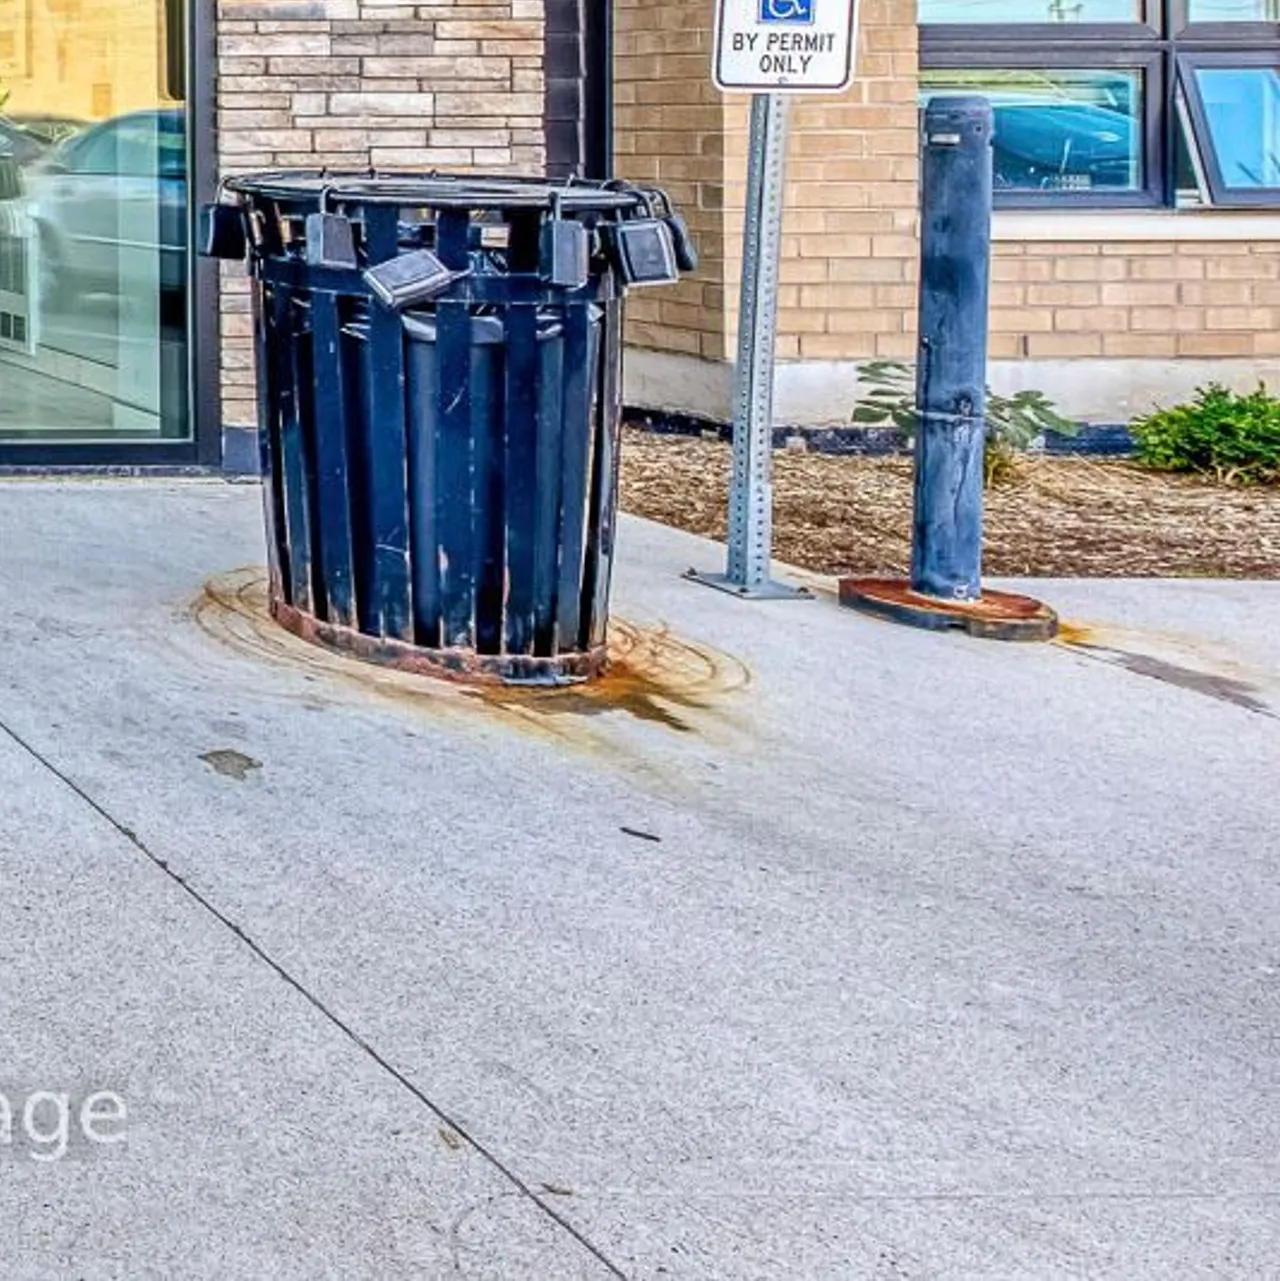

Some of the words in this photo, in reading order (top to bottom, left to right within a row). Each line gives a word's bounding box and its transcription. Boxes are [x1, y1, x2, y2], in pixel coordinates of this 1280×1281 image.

[732, 32, 759, 52] BY
[766, 32, 836, 53] PERMIT
[758, 54, 813, 74] ONLY
